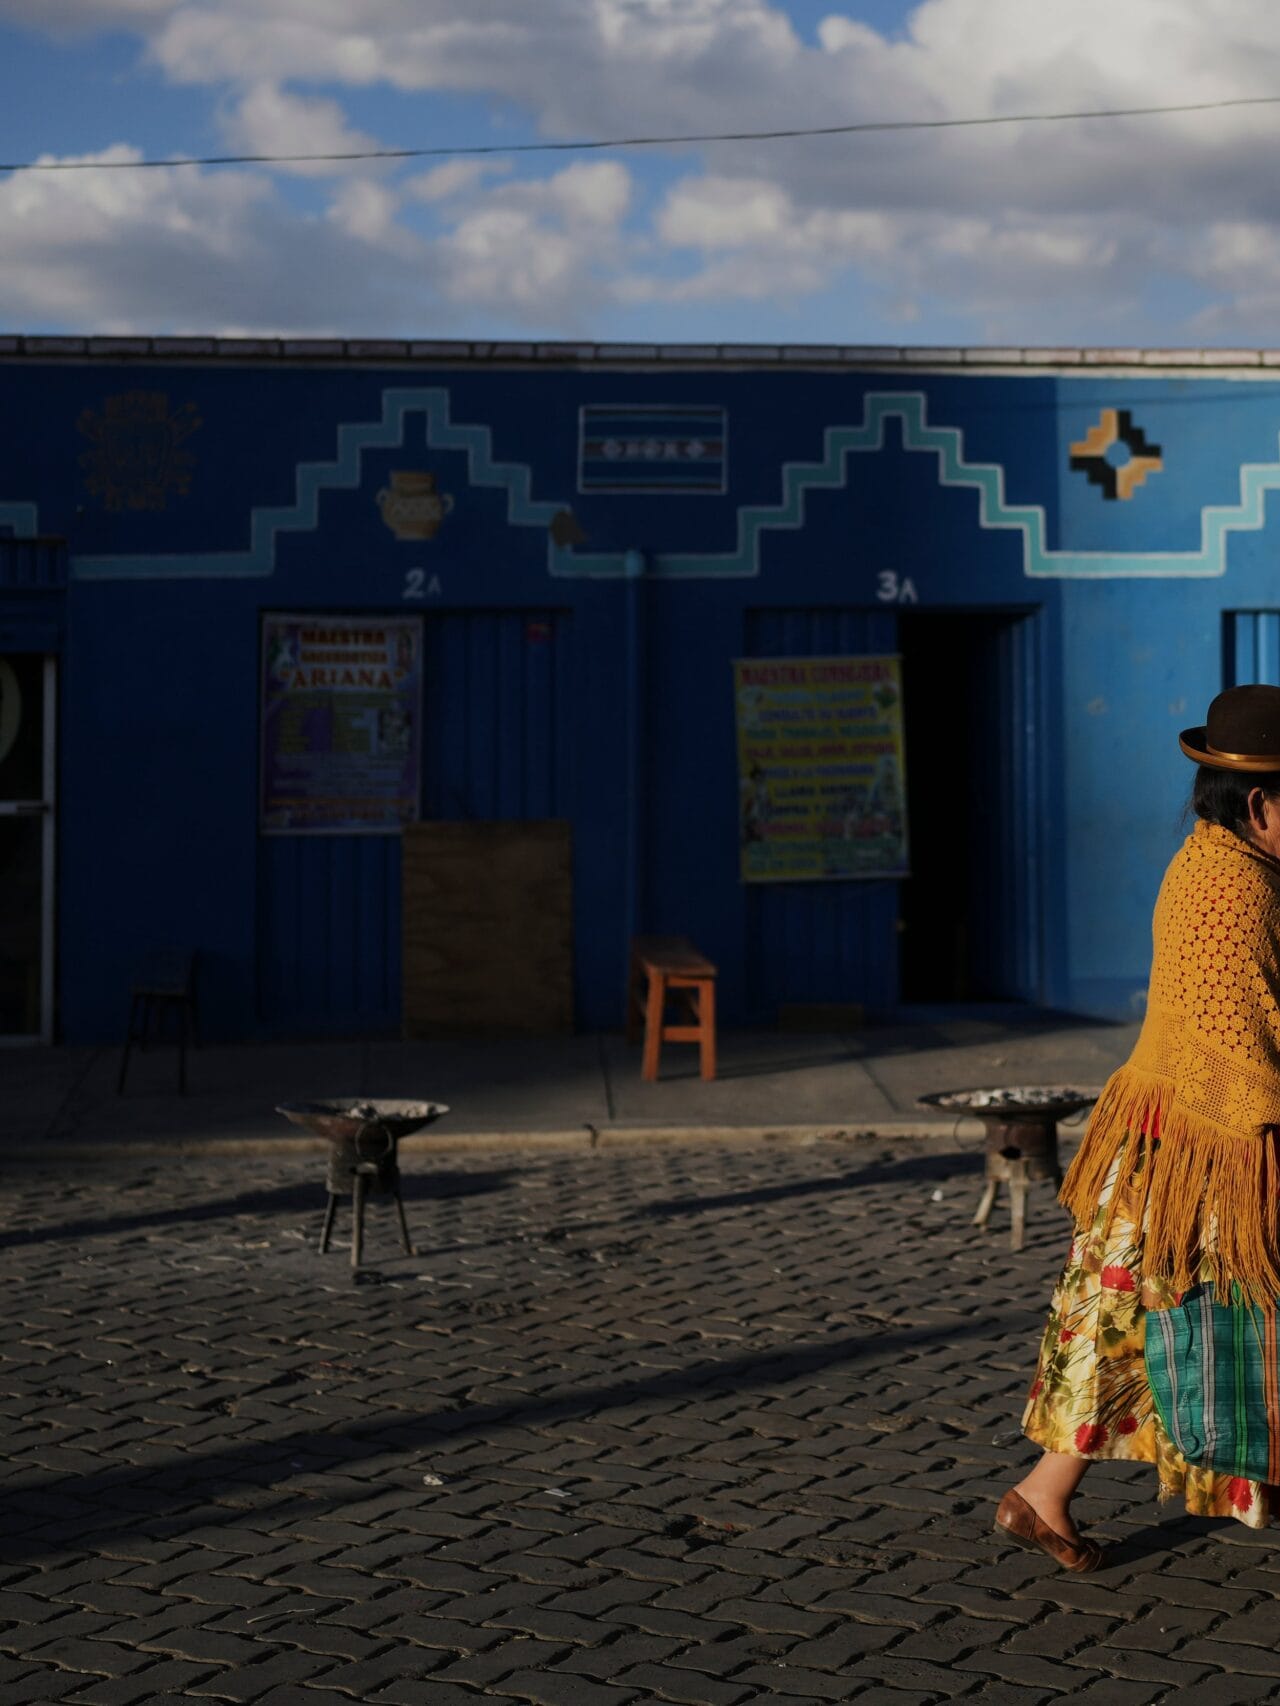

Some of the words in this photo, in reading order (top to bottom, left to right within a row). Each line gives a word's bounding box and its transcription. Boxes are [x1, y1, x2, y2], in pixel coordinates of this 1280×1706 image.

[401, 566, 442, 600] 2A
[876, 569, 919, 604] 3A
[301, 629, 386, 644] MAESTRA
